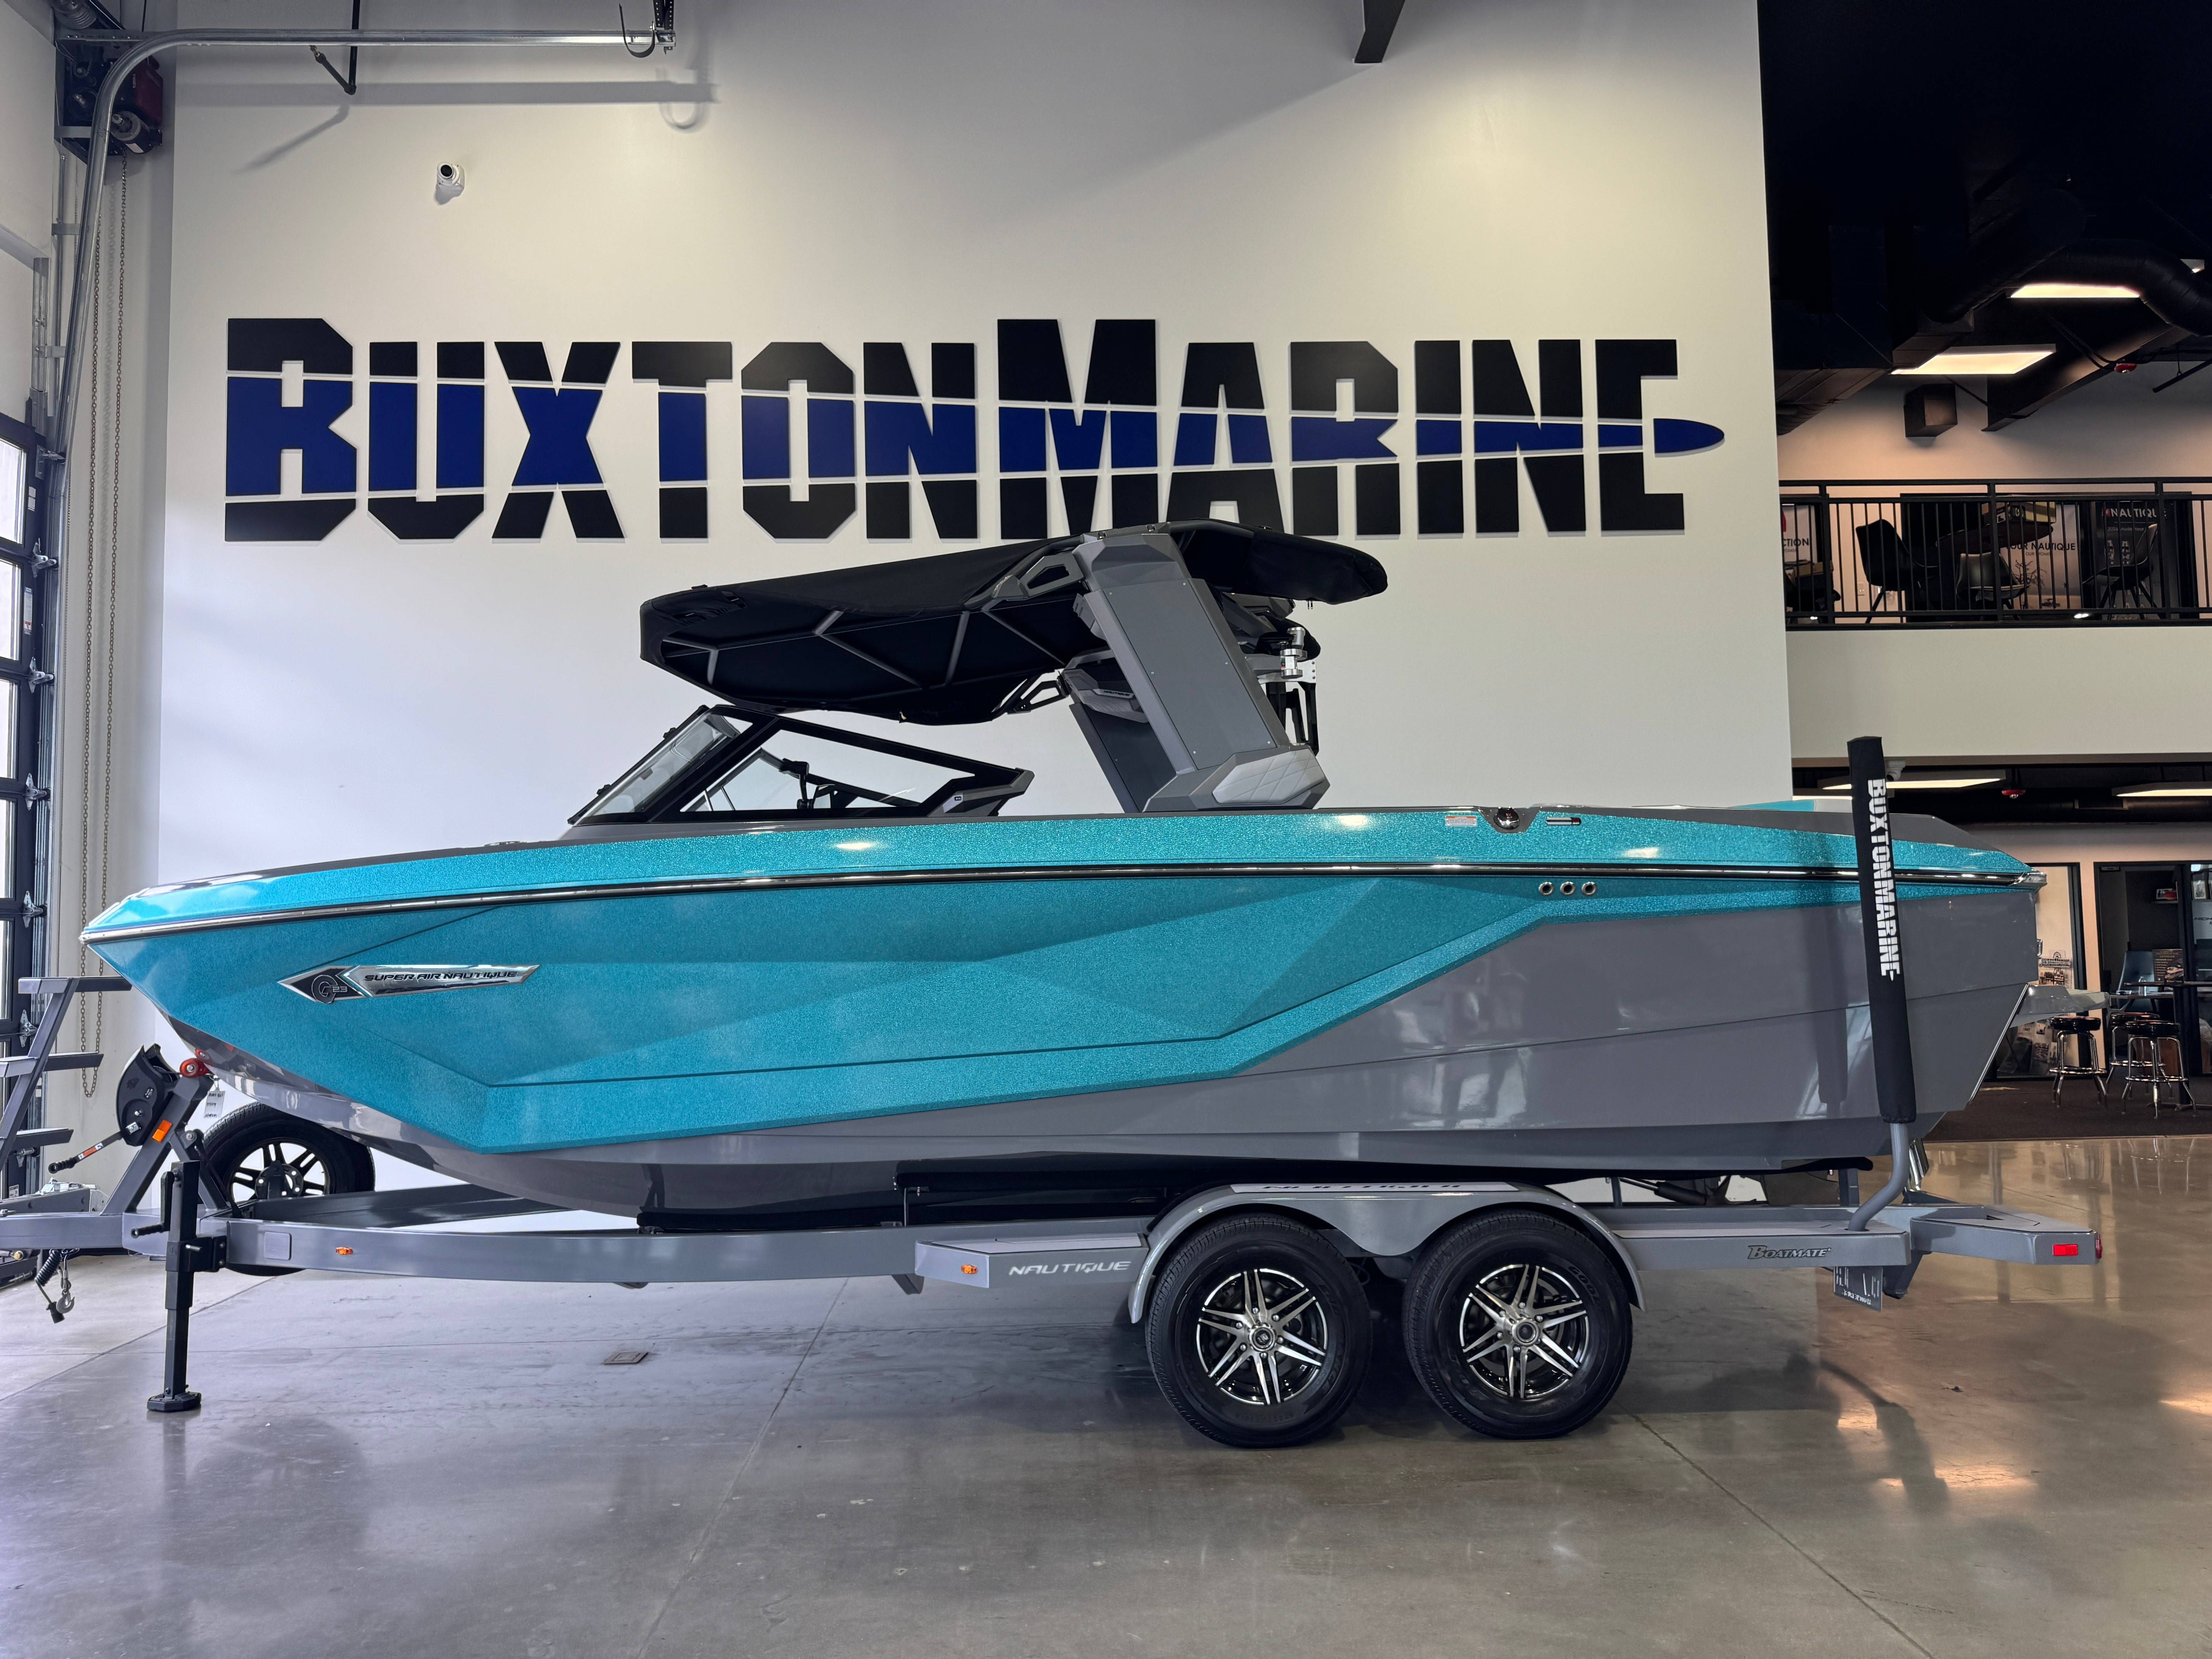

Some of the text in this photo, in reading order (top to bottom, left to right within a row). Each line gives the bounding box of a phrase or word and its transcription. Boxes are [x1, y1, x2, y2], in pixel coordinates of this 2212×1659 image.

[443, 971, 518, 980] NAUTIQUE
[1747, 1245, 1827, 1259] BOATMATE
[1009, 1261, 1132, 1276] NAUTIQUE
